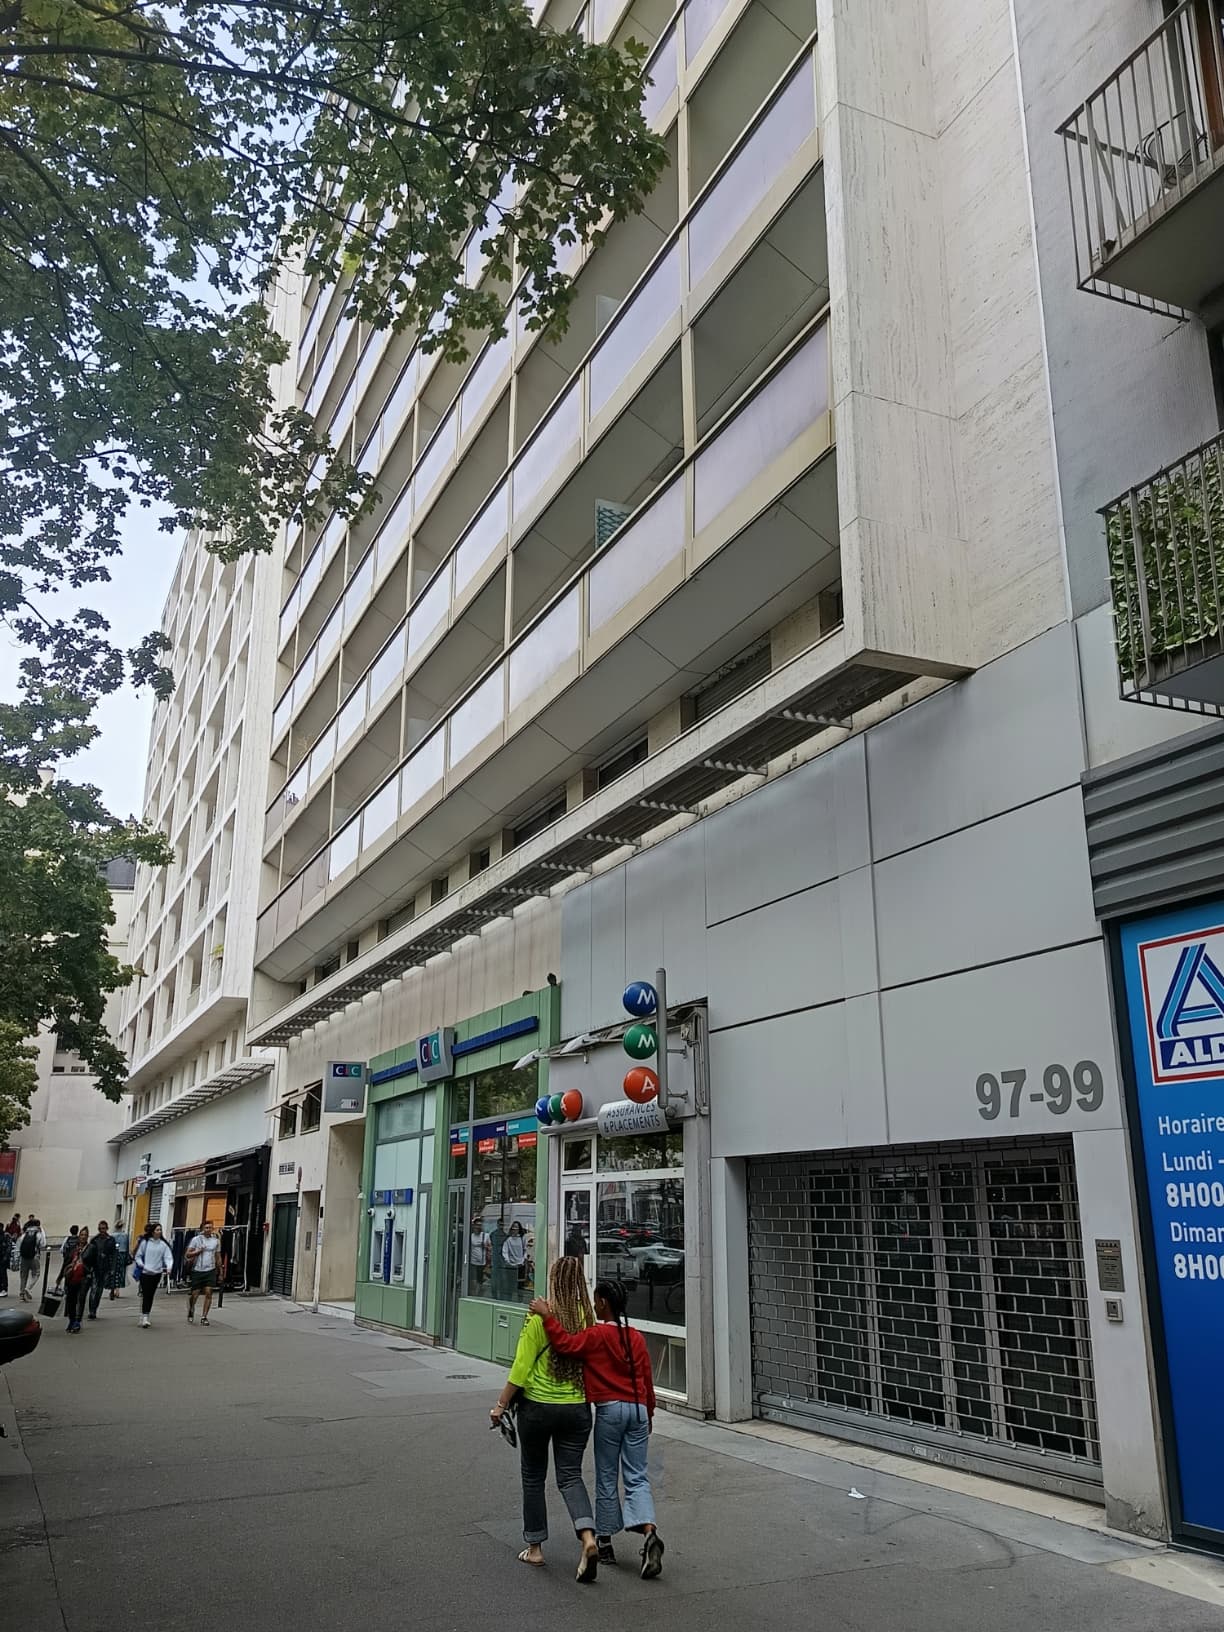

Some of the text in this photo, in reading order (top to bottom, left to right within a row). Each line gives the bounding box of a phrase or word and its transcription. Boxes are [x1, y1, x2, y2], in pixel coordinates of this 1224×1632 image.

[975, 1060, 1104, 1120] 97-99
[606, 1101, 656, 1118] ASSURANCES
[610, 1114, 660, 1131] PLACEMENTS
[1162, 1150, 1213, 1172] Lundi
[1166, 1182, 1224, 1207] 8H00
